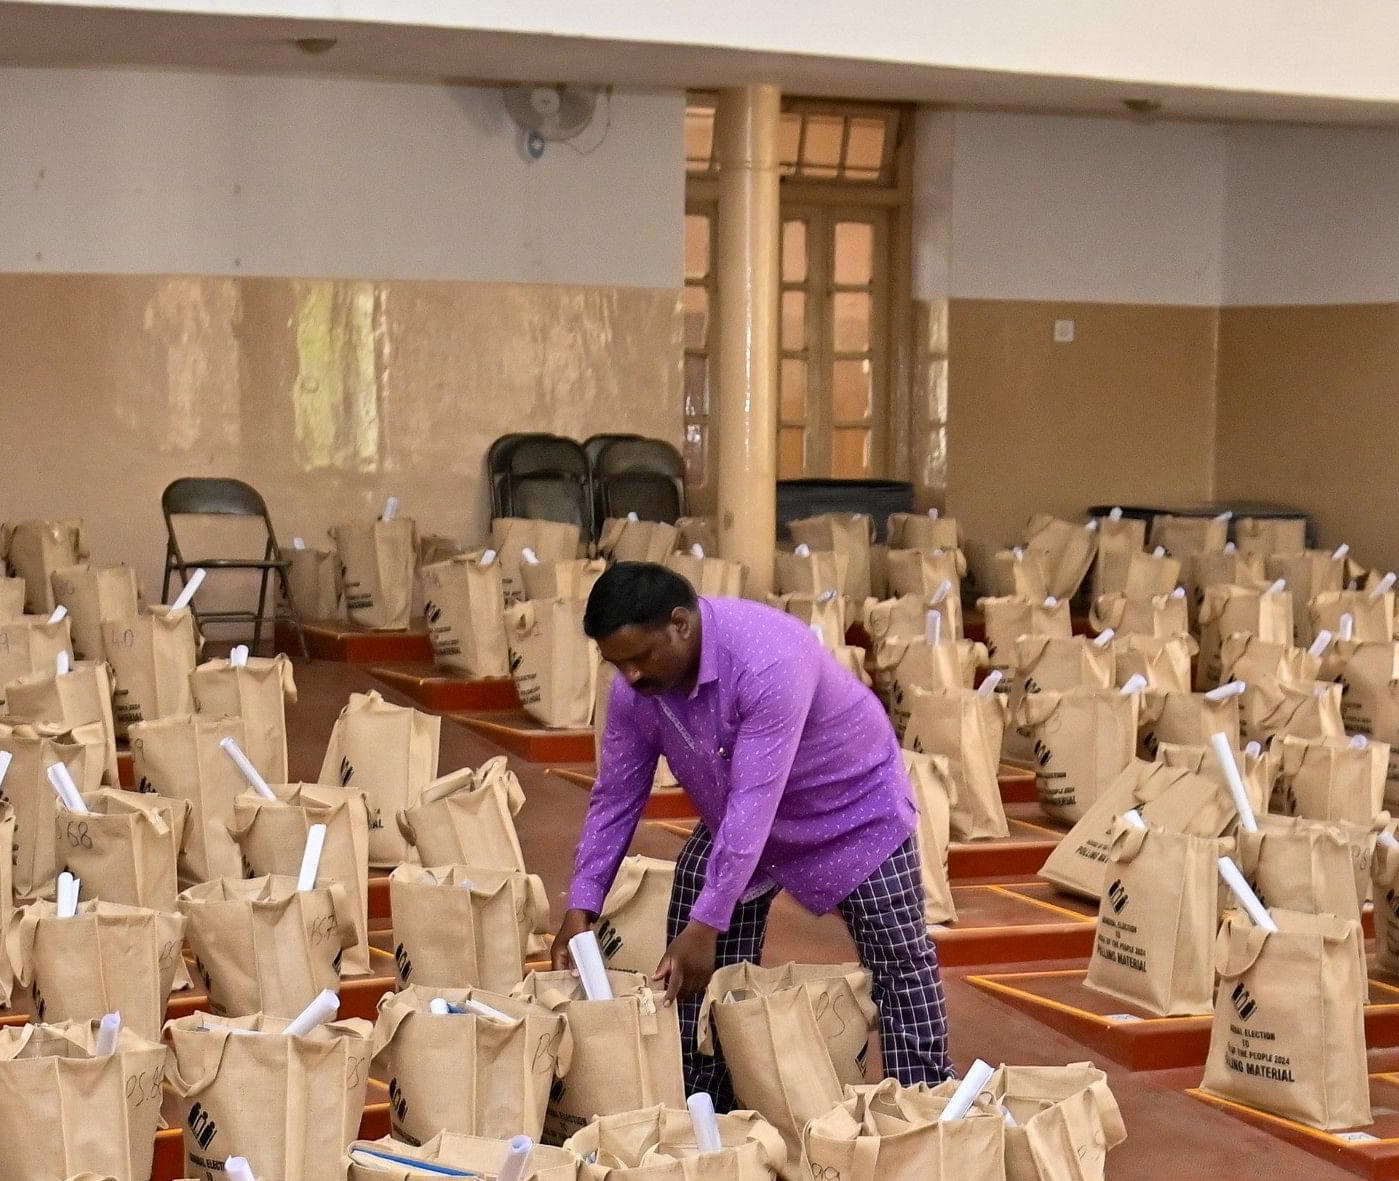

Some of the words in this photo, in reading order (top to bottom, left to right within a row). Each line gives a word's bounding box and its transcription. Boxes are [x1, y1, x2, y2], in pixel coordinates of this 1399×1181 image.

[1245, 1025, 1276, 1041] ELECTION
[1248, 1049, 1273, 1063] PEOPLE
[1246, 1061, 1296, 1083] MATERIAL
